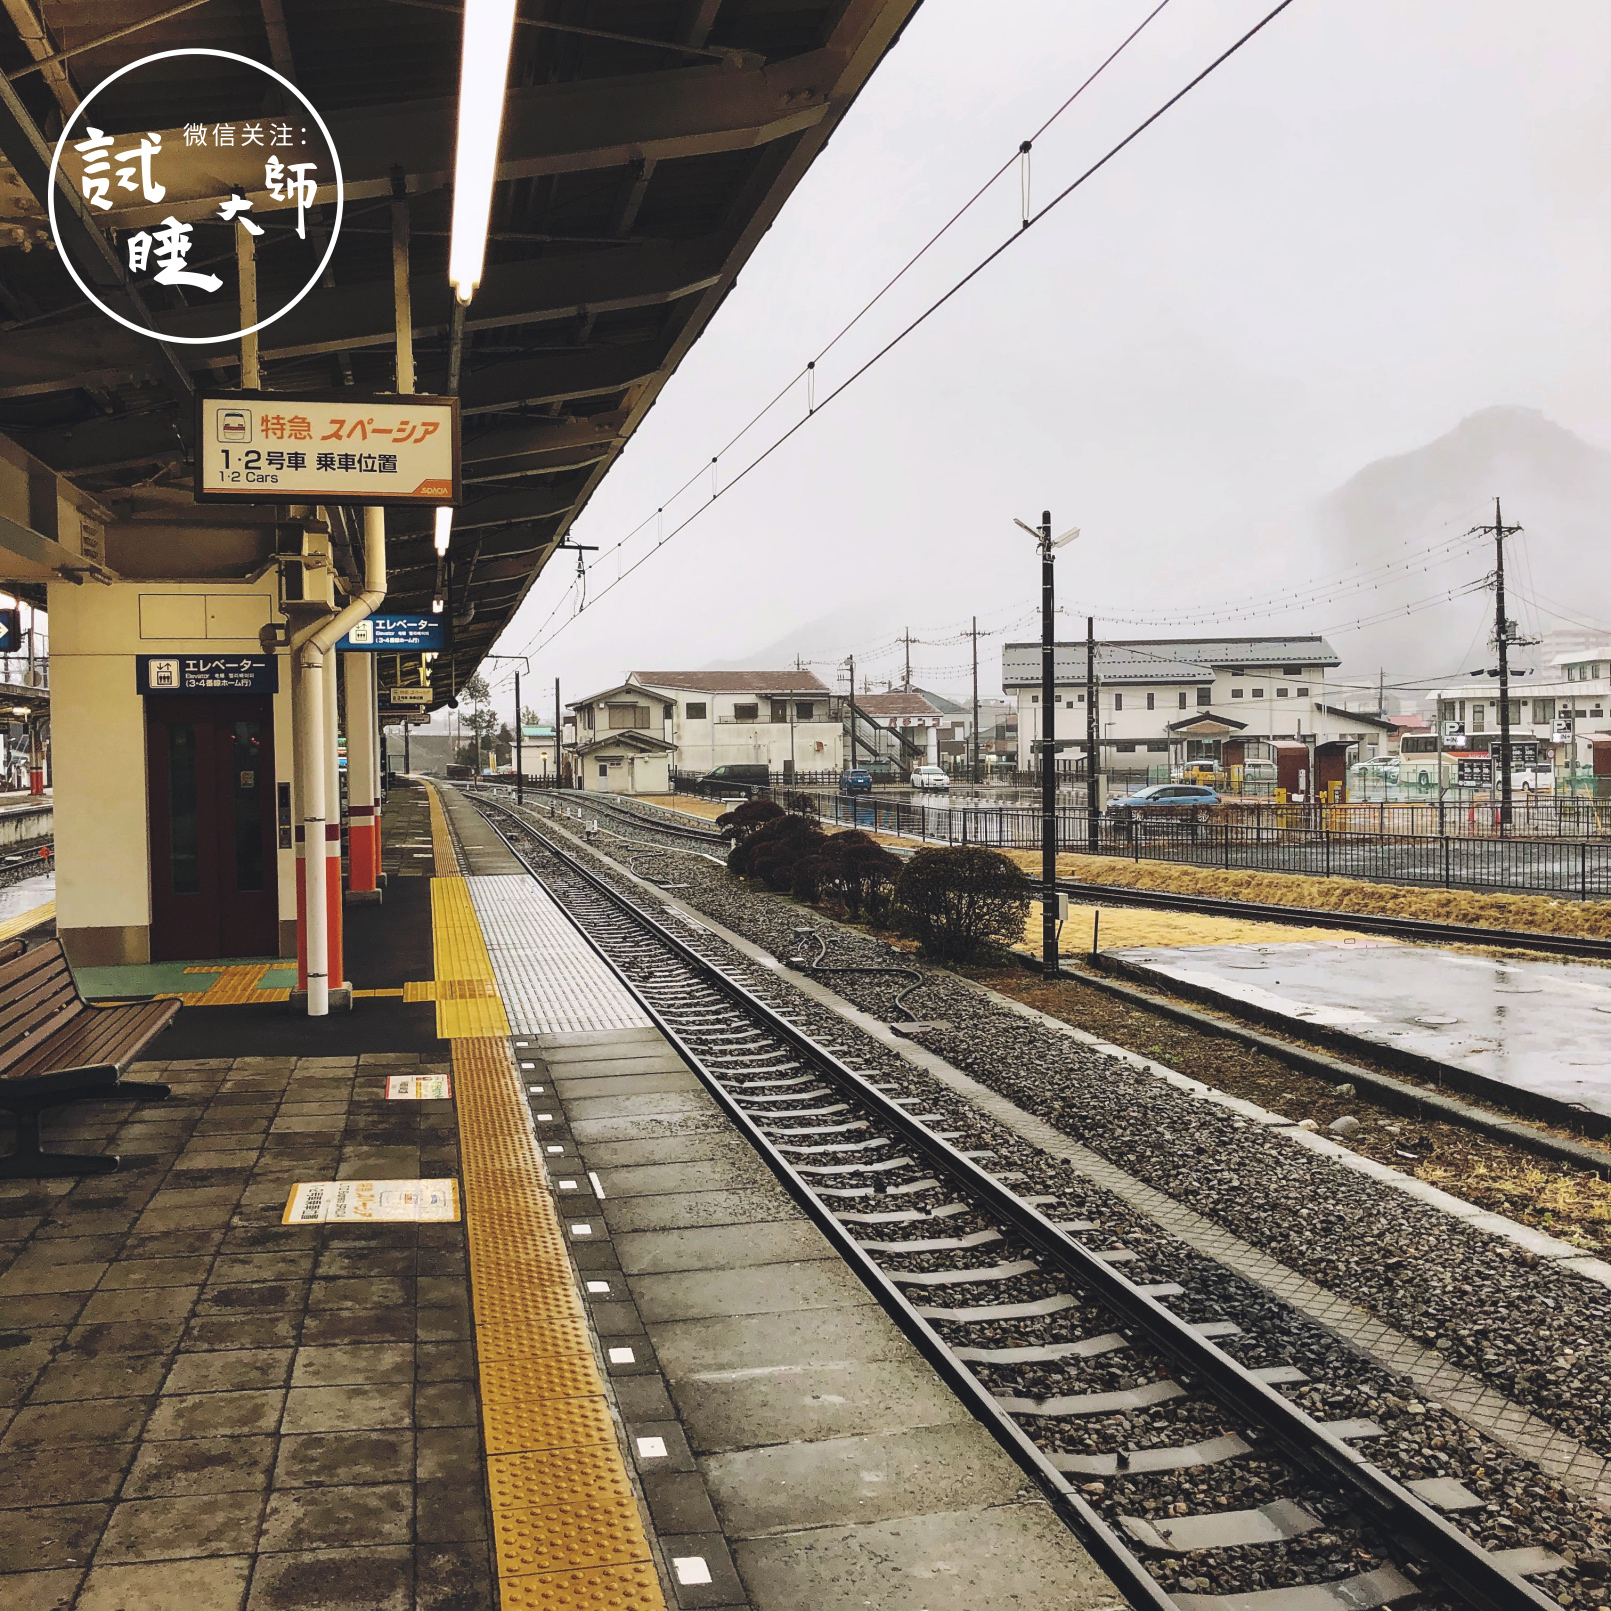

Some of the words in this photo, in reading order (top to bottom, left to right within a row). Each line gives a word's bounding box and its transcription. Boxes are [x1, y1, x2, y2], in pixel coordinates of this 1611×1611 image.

[260, 415, 313, 440] 特急
[320, 417, 440, 444] スペーシア
[315, 452, 398, 474] 乗車位置
[245, 471, 279, 484] Cars
[375, 619, 439, 630] エレベーター
[185, 659, 266, 672] エレベーター
[1445, 722, 1459, 735] P
[1553, 720, 1567, 733] P
